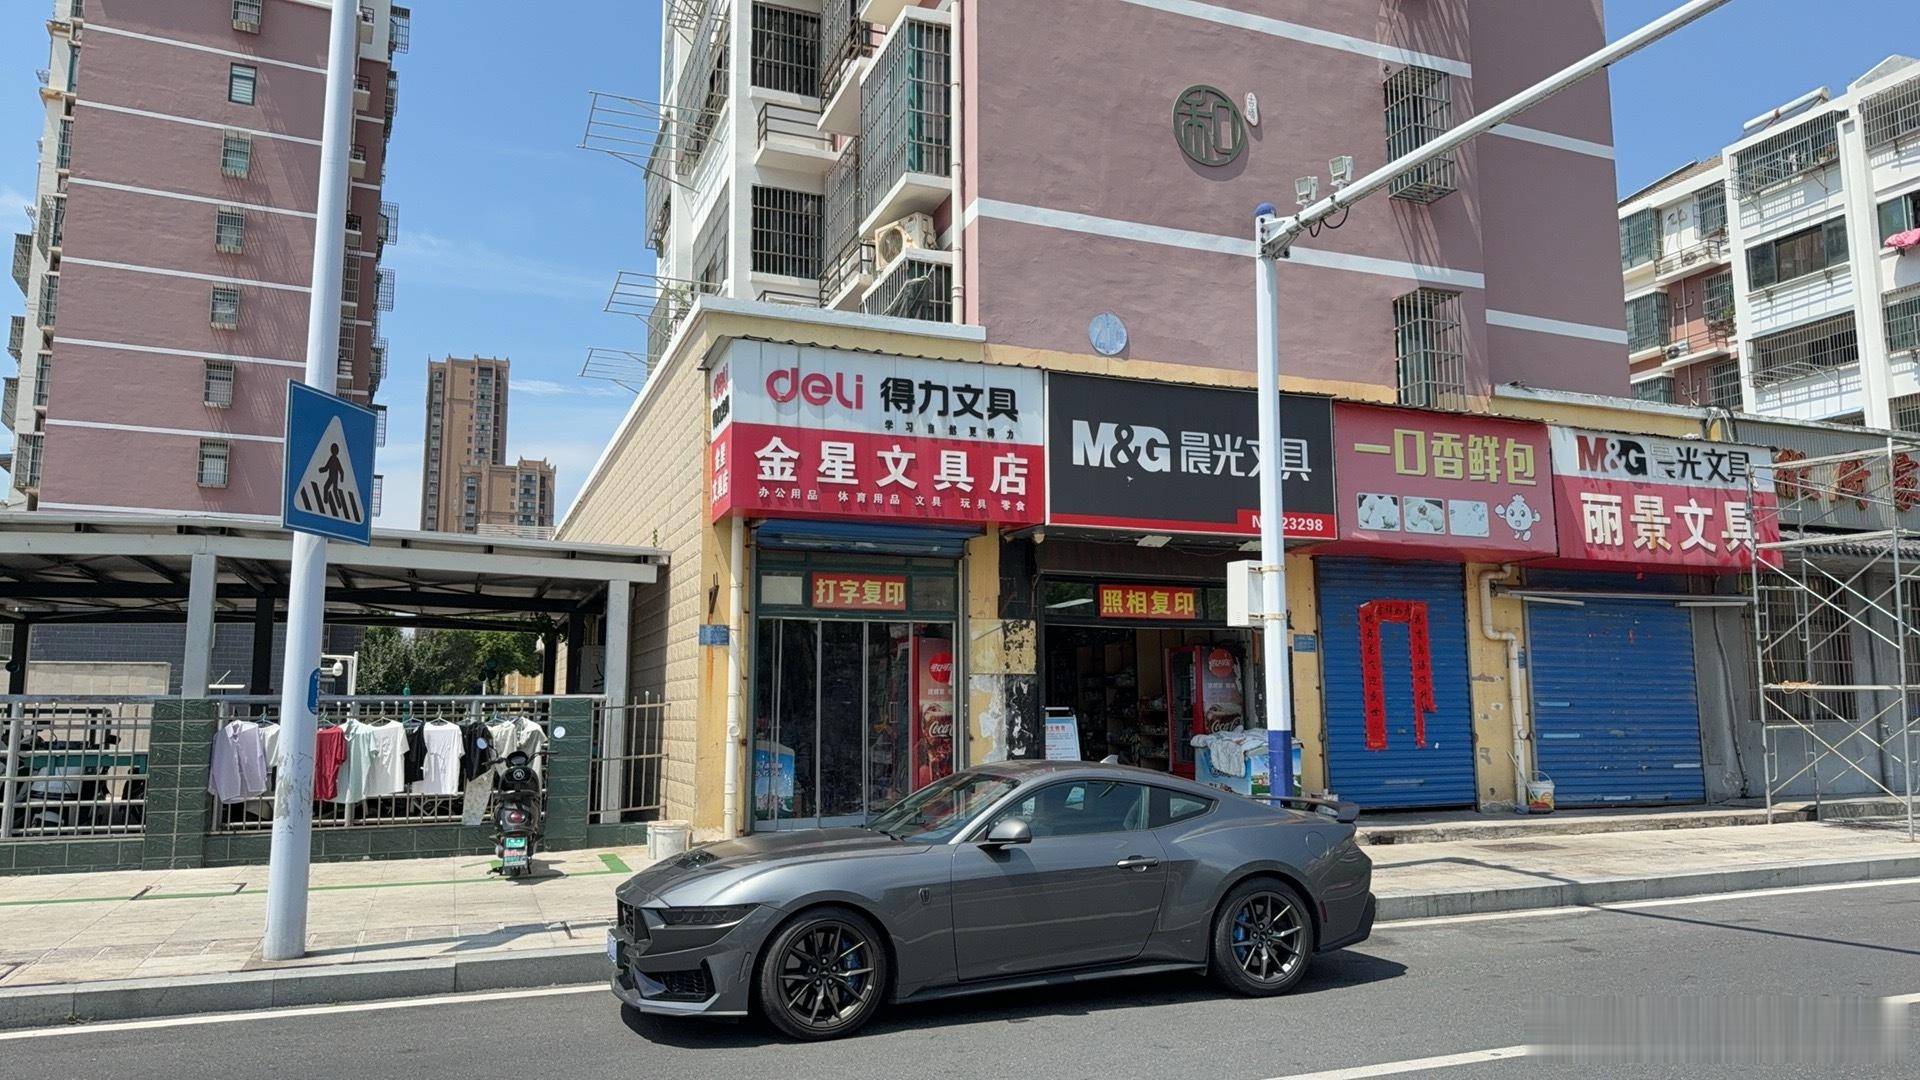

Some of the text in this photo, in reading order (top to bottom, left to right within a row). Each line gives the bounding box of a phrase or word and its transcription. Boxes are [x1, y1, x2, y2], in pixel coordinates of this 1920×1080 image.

[766, 367, 1018, 422] deli 得力文具
[754, 436, 1028, 495] 金星文具店
[1072, 419, 1171, 473] M&G
[1354, 428, 1537, 486] 一口香鲜包
[1576, 435, 1647, 475] M&G
[758, 486, 1026, 512] 办公用品 体育用品 文具 玩具 零食
[1580, 492, 1760, 552] 丽景文具
[816, 578, 904, 606] 打字复印
[1102, 589, 1194, 616] 照相复印
